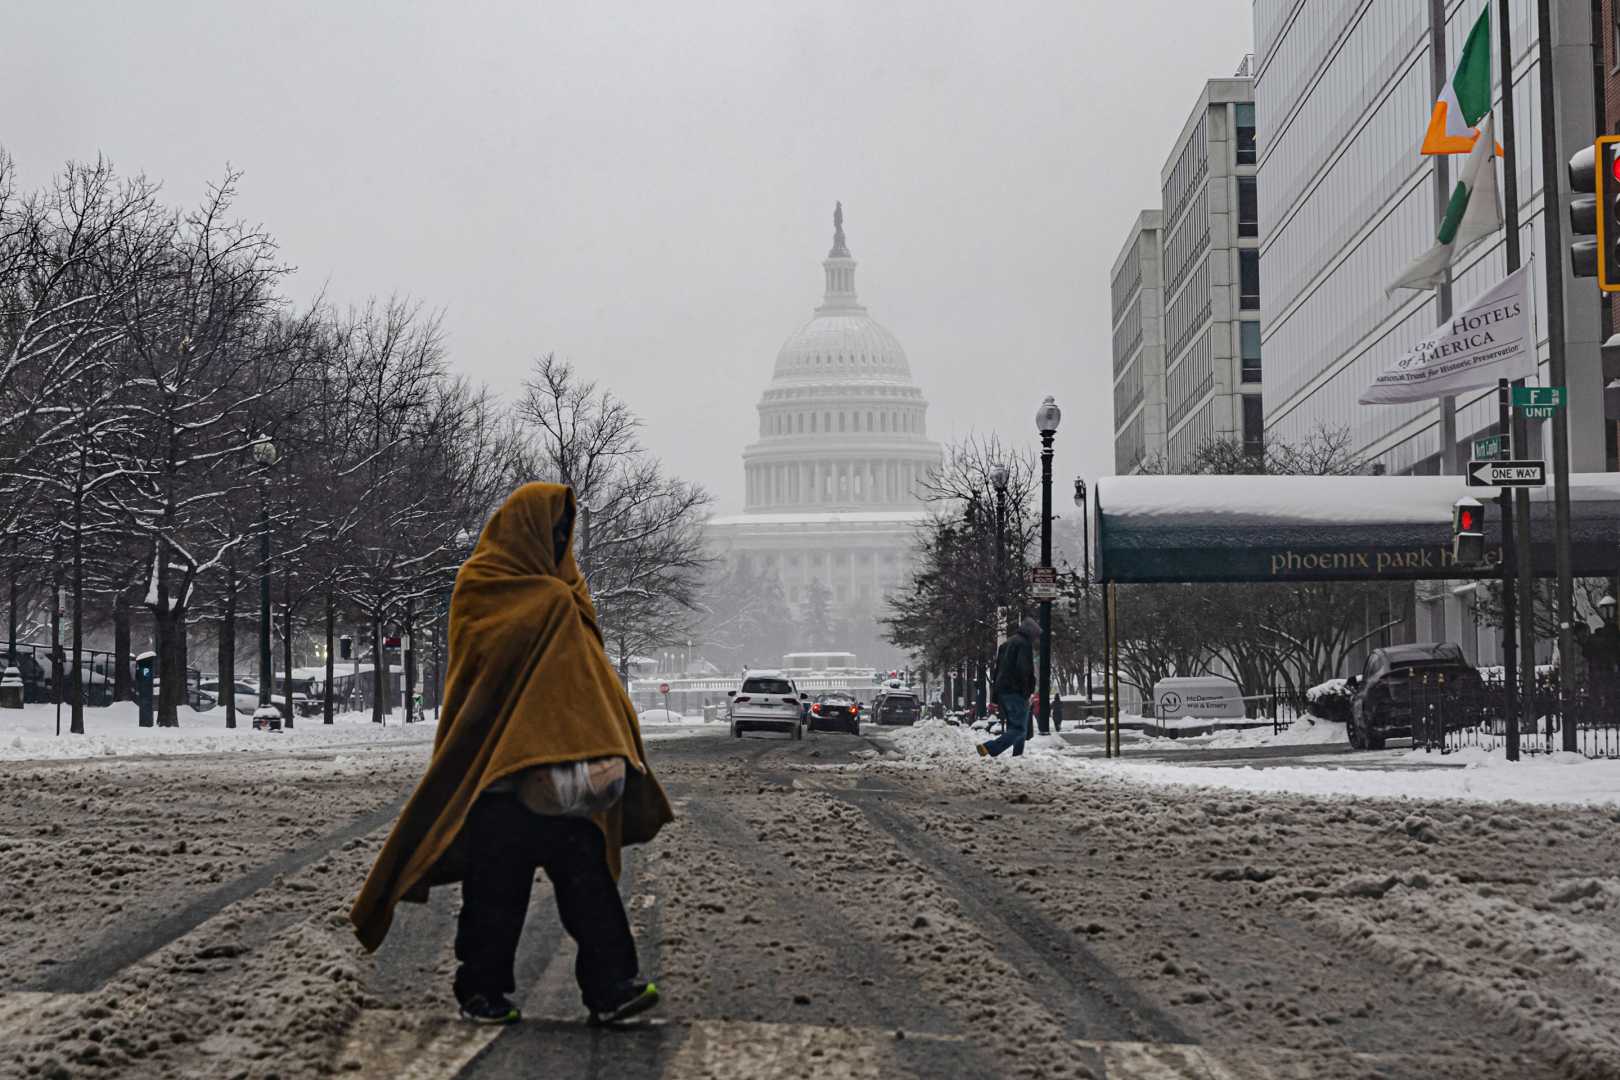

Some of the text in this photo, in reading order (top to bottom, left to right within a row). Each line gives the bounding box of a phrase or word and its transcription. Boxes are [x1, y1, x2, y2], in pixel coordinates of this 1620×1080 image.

[1452, 302, 1521, 335] HOTELS
[1416, 332, 1495, 365] AMERICA
[1440, 359, 1471, 374] Historic
[1472, 344, 1520, 363] Preservation
[1530, 390, 1540, 404] F
[1526, 407, 1552, 417] UNIT
[1492, 468, 1537, 479] ONE WAY
